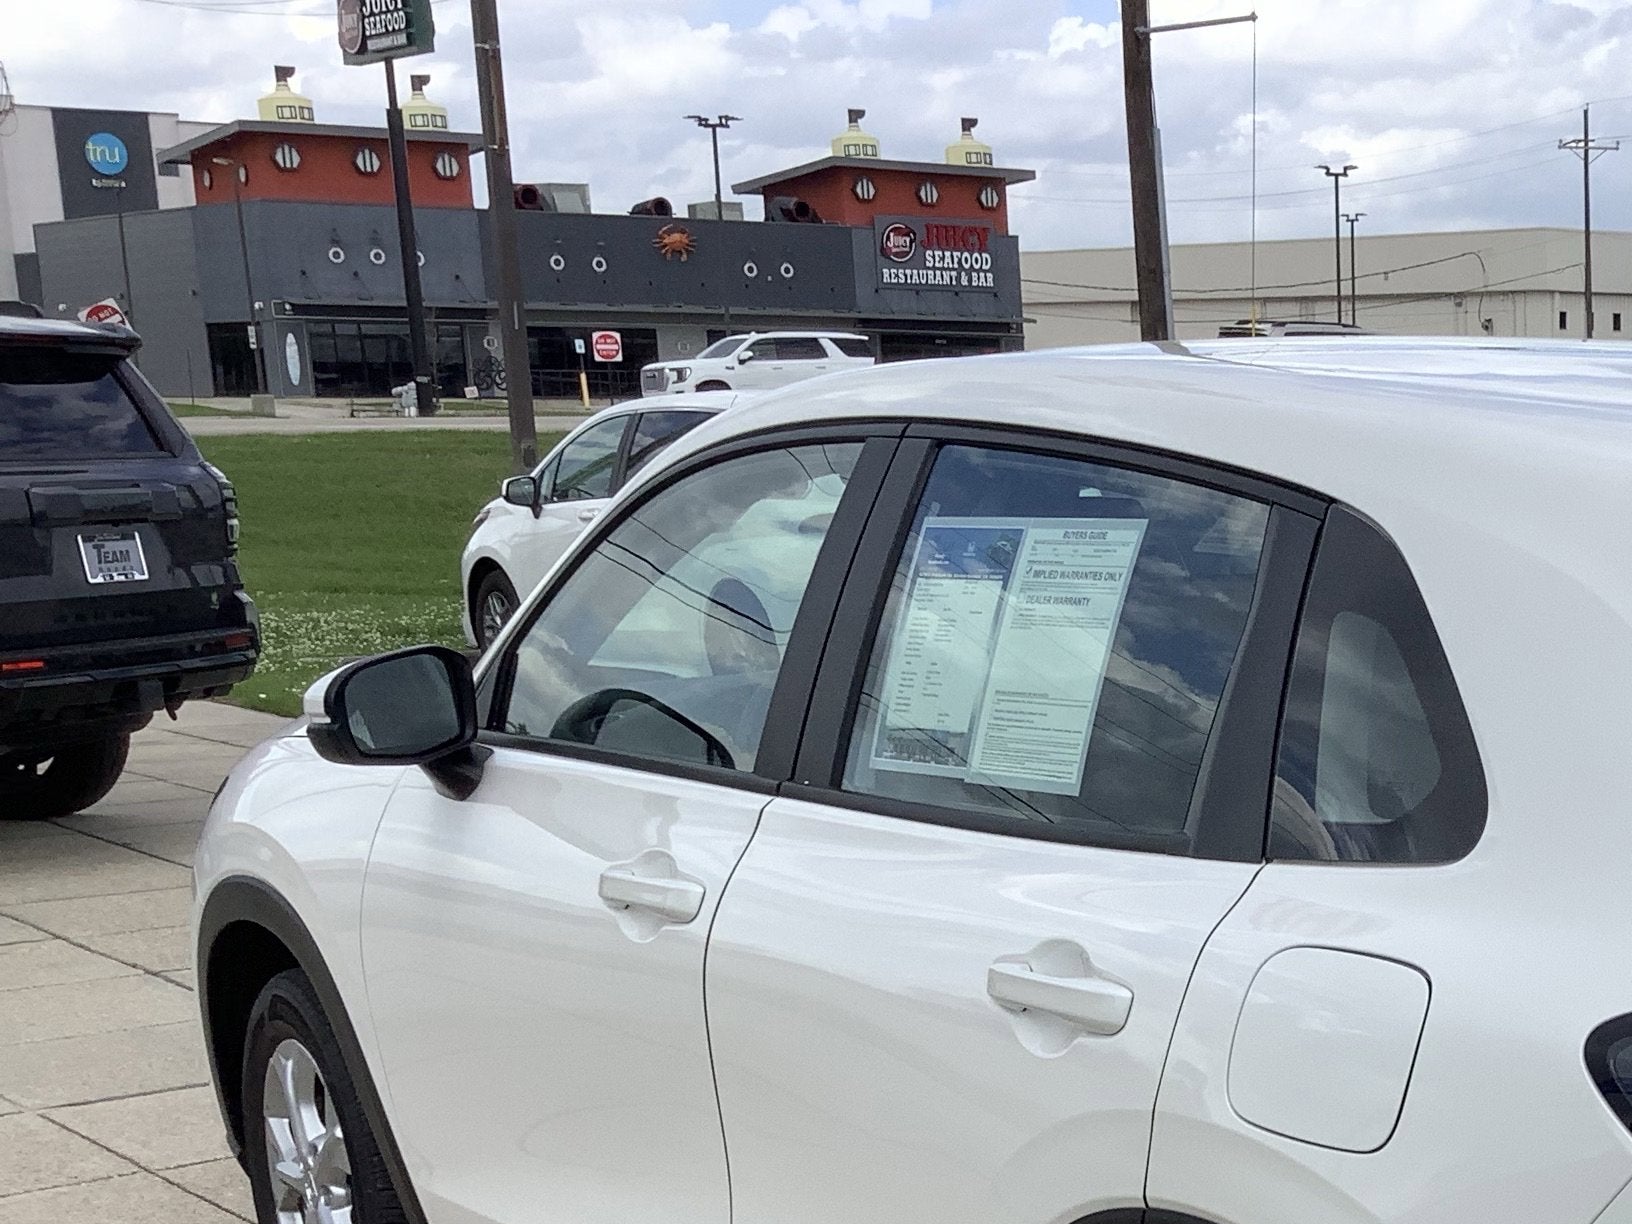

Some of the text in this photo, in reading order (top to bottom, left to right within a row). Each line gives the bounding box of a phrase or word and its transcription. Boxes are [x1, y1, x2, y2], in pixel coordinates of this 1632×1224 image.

[364, 11, 406, 36] SEAFOOD
[85, 140, 120, 163] tru
[921, 223, 990, 252] JUICY
[925, 250, 992, 270] SEAFOOD
[882, 268, 994, 287] RESTAURANT & BAR
[1062, 530, 1109, 541] BUYERS GUIDE
[92, 543, 131, 565] TEAM
[1032, 569, 1124, 582] IMPLIED WARRANTIES ONLY
[1025, 595, 1091, 607] DEALER WARRANTY
